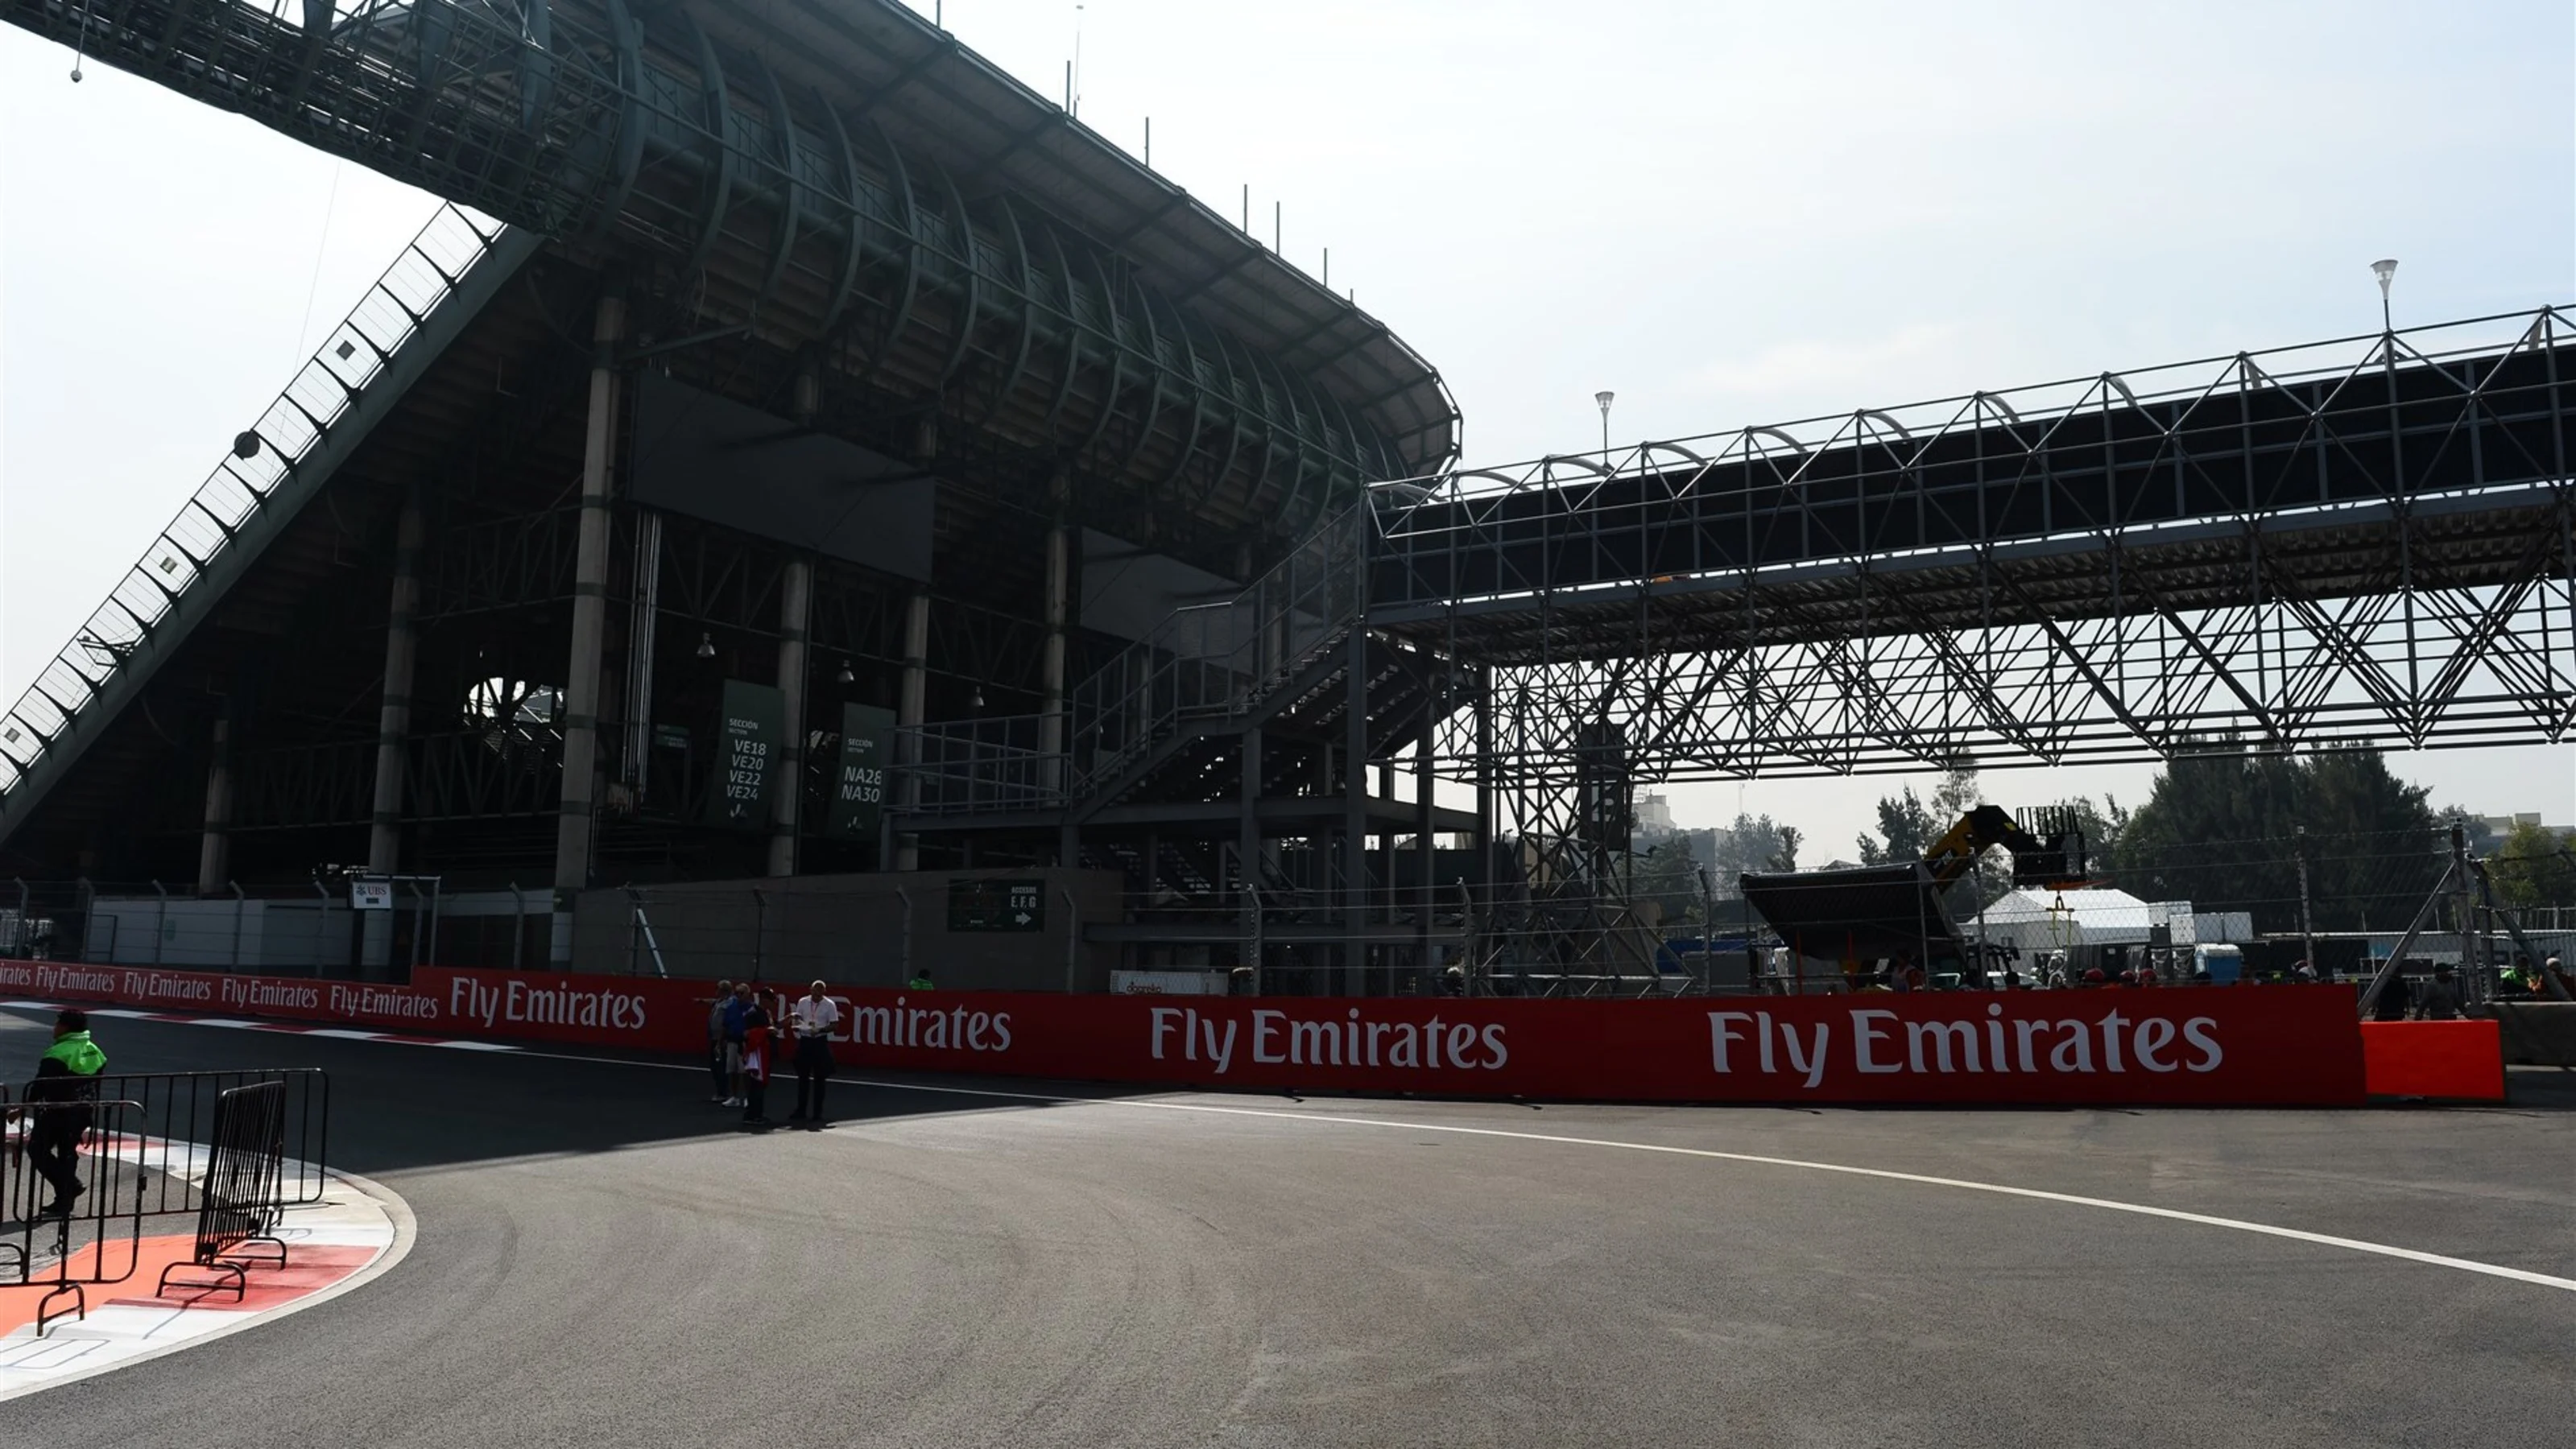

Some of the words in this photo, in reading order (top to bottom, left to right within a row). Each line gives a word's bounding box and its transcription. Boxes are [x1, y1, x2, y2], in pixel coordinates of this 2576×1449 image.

[729, 718, 759, 730] SECCIÓN
[734, 738, 767, 757] VE18
[847, 737, 874, 749] SECCIÓN
[731, 753, 764, 771] VE20
[729, 769, 762, 786] VE22
[844, 765, 883, 786] NA28
[726, 784, 759, 801] VE24
[841, 783, 881, 803] NA30
[367, 885, 387, 896] UBS
[1029, 895, 1037, 908] G
[35, 966, 58, 993] Fly
[59, 966, 115, 993] Emirates
[123, 971, 147, 1000] Fly
[148, 972, 211, 1000] Emirates
[221, 977, 248, 1008] Fly
[250, 979, 319, 1009] Emirates
[330, 985, 360, 1017] Fly
[361, 987, 439, 1019] Emirates
[450, 976, 499, 1028] Fly
[506, 980, 646, 1030] Emirates
[1151, 1008, 1237, 1074] Fly
[1251, 1008, 1508, 1070] Emirates
[1706, 1011, 1830, 1088] Fly
[1849, 1002, 2224, 1073] Emirates
